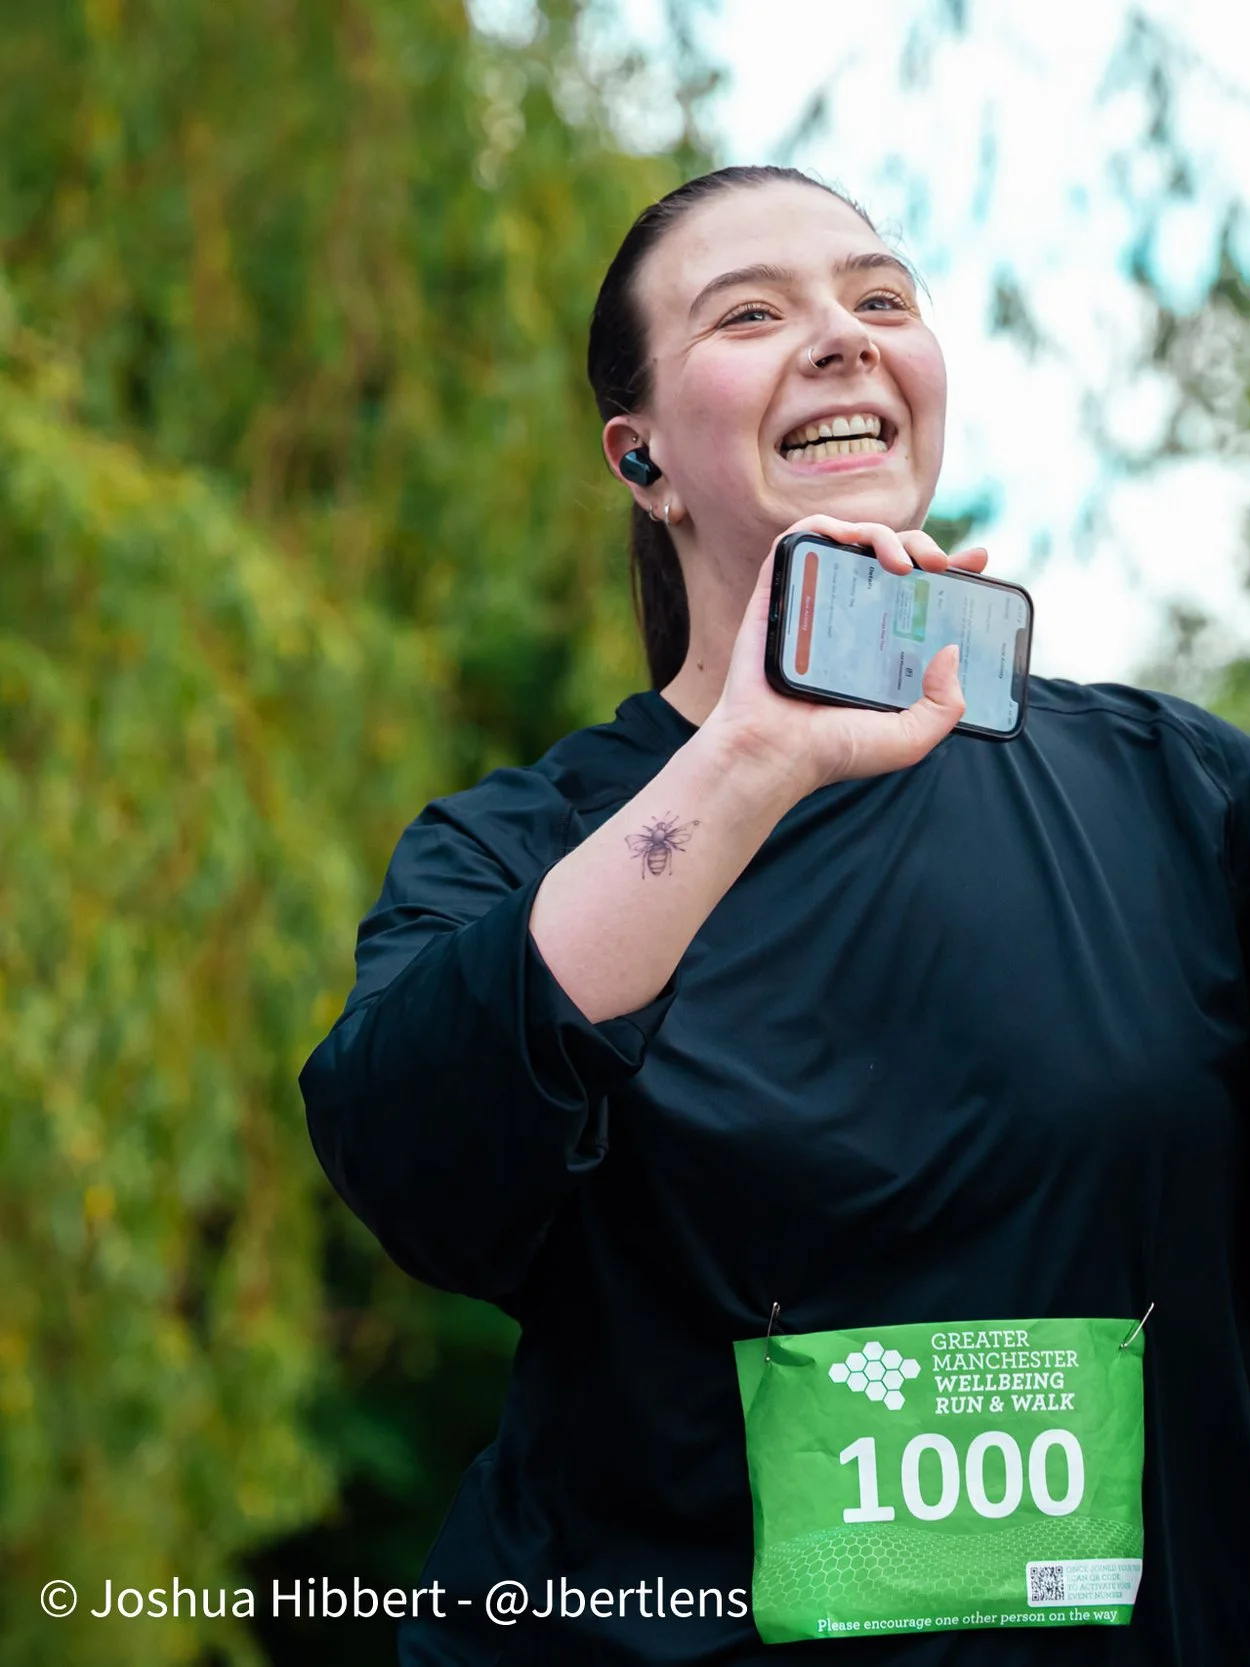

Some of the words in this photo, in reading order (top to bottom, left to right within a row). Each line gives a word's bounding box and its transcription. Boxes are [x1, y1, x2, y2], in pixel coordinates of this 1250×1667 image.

[931, 1330, 1030, 1350] GREATER
[932, 1350, 1079, 1371] MANCHESTER
[934, 1372, 1065, 1393] WELLBEING
[935, 1395, 984, 1414] RUN
[989, 1395, 1004, 1413] &
[1011, 1393, 1075, 1412] WALK
[839, 1428, 1085, 1524] 1000
[1068, 1592, 1093, 1600] EVENT
[1080, 1582, 1116, 1590] ACTIVATE
[817, 1617, 860, 1633] Please
[863, 1616, 932, 1630] encourage
[935, 1616, 959, 1626] one
[962, 1612, 997, 1625] other
[1000, 1612, 1045, 1625] person
[1049, 1611, 1067, 1621] on
[1069, 1608, 1091, 1621] the
[1092, 1609, 1118, 1622] way
